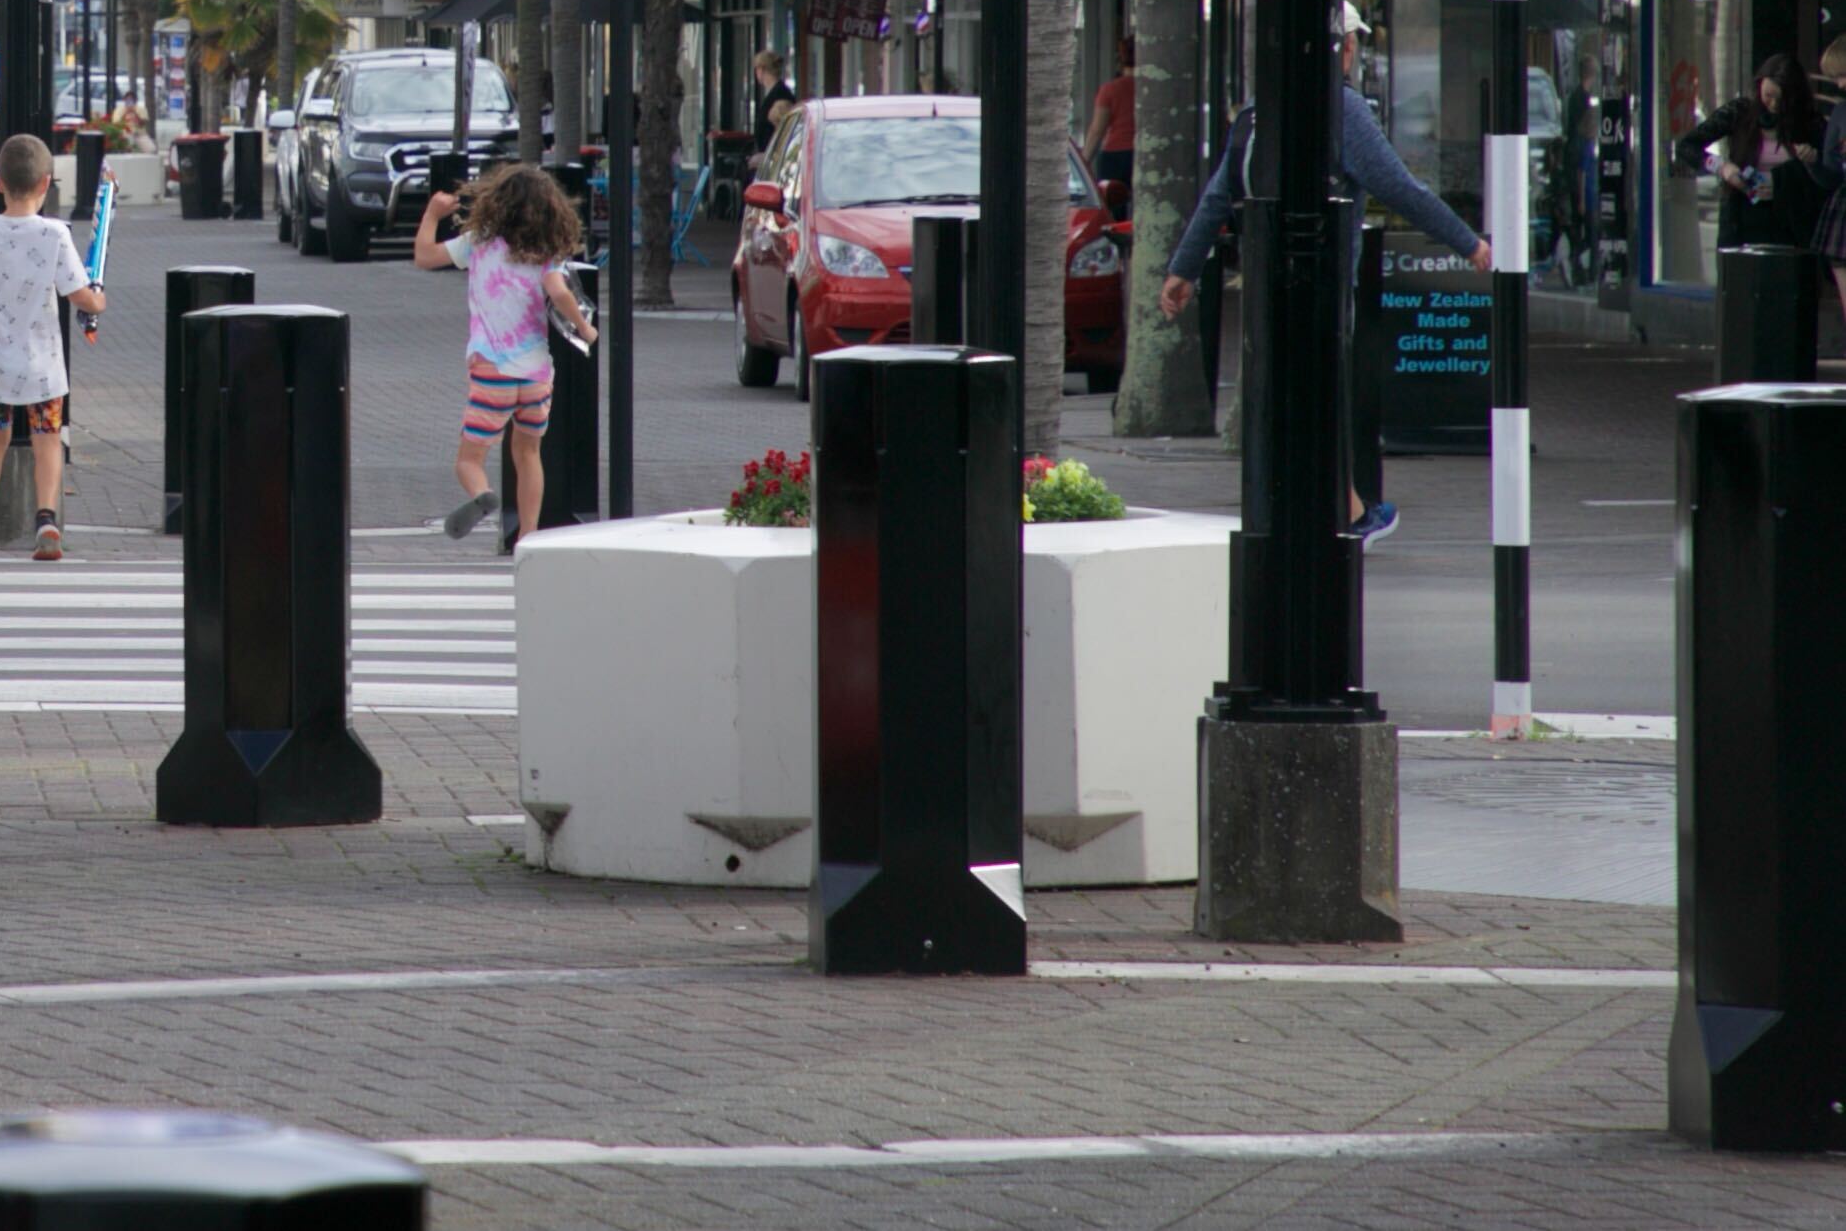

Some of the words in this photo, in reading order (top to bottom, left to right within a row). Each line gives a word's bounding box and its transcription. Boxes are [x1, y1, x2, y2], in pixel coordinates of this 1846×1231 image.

[812, 18, 836, 36] OPE
[842, 19, 877, 38] OPEN
[1382, 293, 1423, 307] New
[1429, 291, 1493, 308] Zealan
[1418, 313, 1471, 328] Made
[1398, 334, 1445, 351] Gifts
[1452, 334, 1488, 350] and
[1395, 357, 1491, 376] Jewellery
